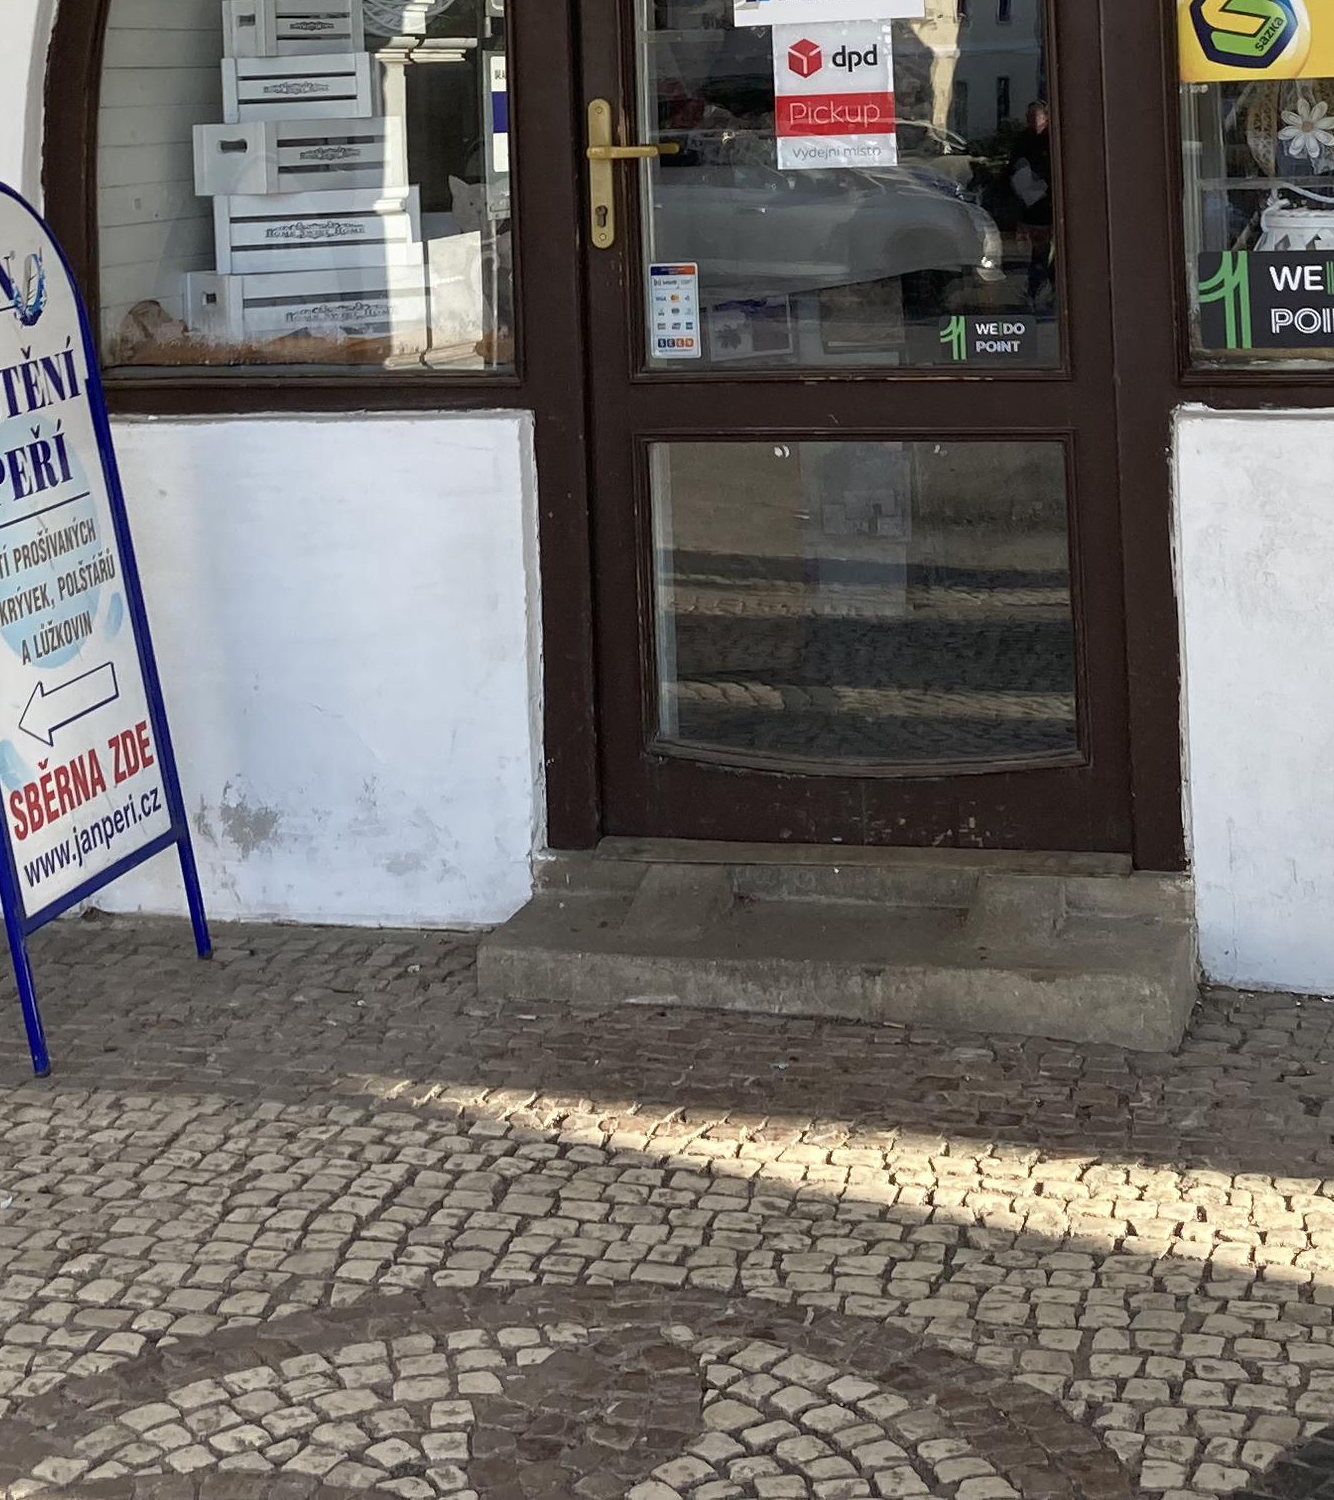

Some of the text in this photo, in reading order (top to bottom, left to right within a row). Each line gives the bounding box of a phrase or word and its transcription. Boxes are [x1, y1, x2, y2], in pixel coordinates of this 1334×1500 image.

[831, 43, 878, 73] dpd
[1255, 17, 1285, 51] sazka
[789, 100, 880, 128] Pickup
[975, 340, 1021, 352] POINT
[13, 517, 97, 573] PROŠÍVANÝCH
[57, 547, 116, 601] POLŠTÁŘŮ
[22, 610, 93, 665] A LŮŽKOVIN
[9, 720, 155, 841] SBĚRNA ZDE
[23, 787, 162, 887] www.janperi.cz
